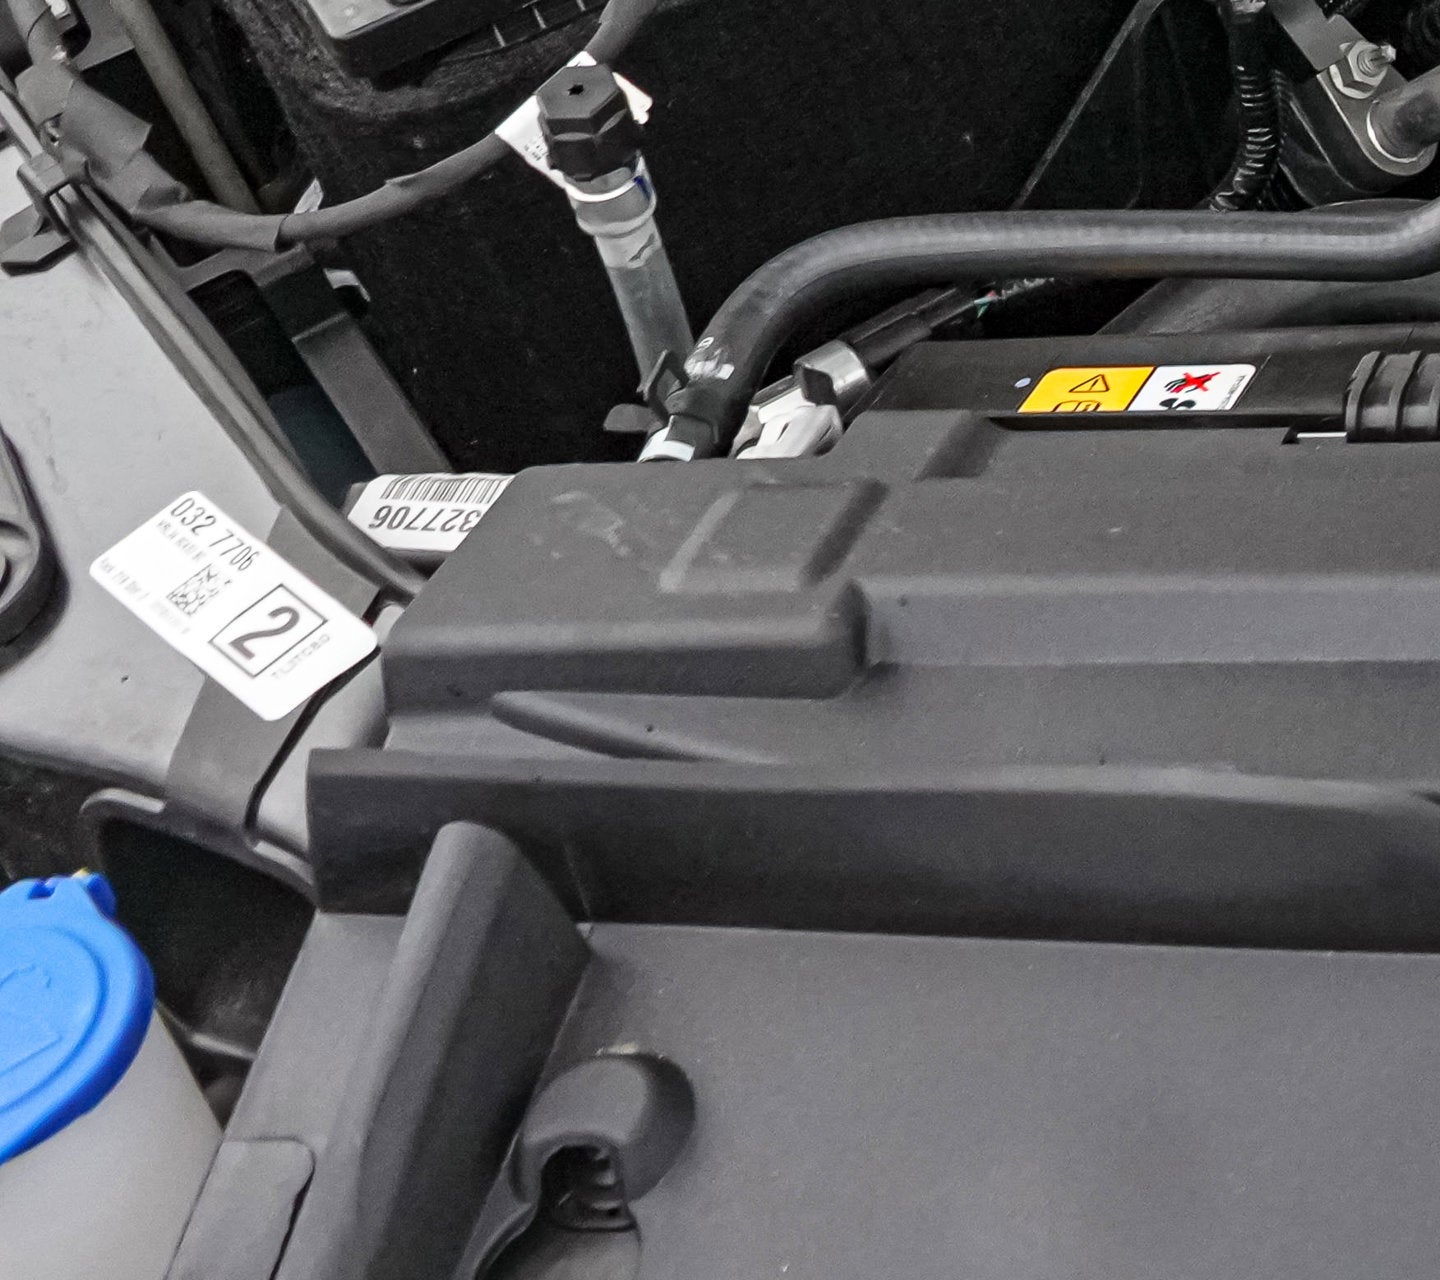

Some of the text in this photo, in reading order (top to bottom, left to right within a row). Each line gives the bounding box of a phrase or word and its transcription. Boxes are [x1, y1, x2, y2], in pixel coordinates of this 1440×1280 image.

[170, 496, 215, 540] 032
[211, 523, 260, 572] 7706
[228, 606, 299, 661] 2
